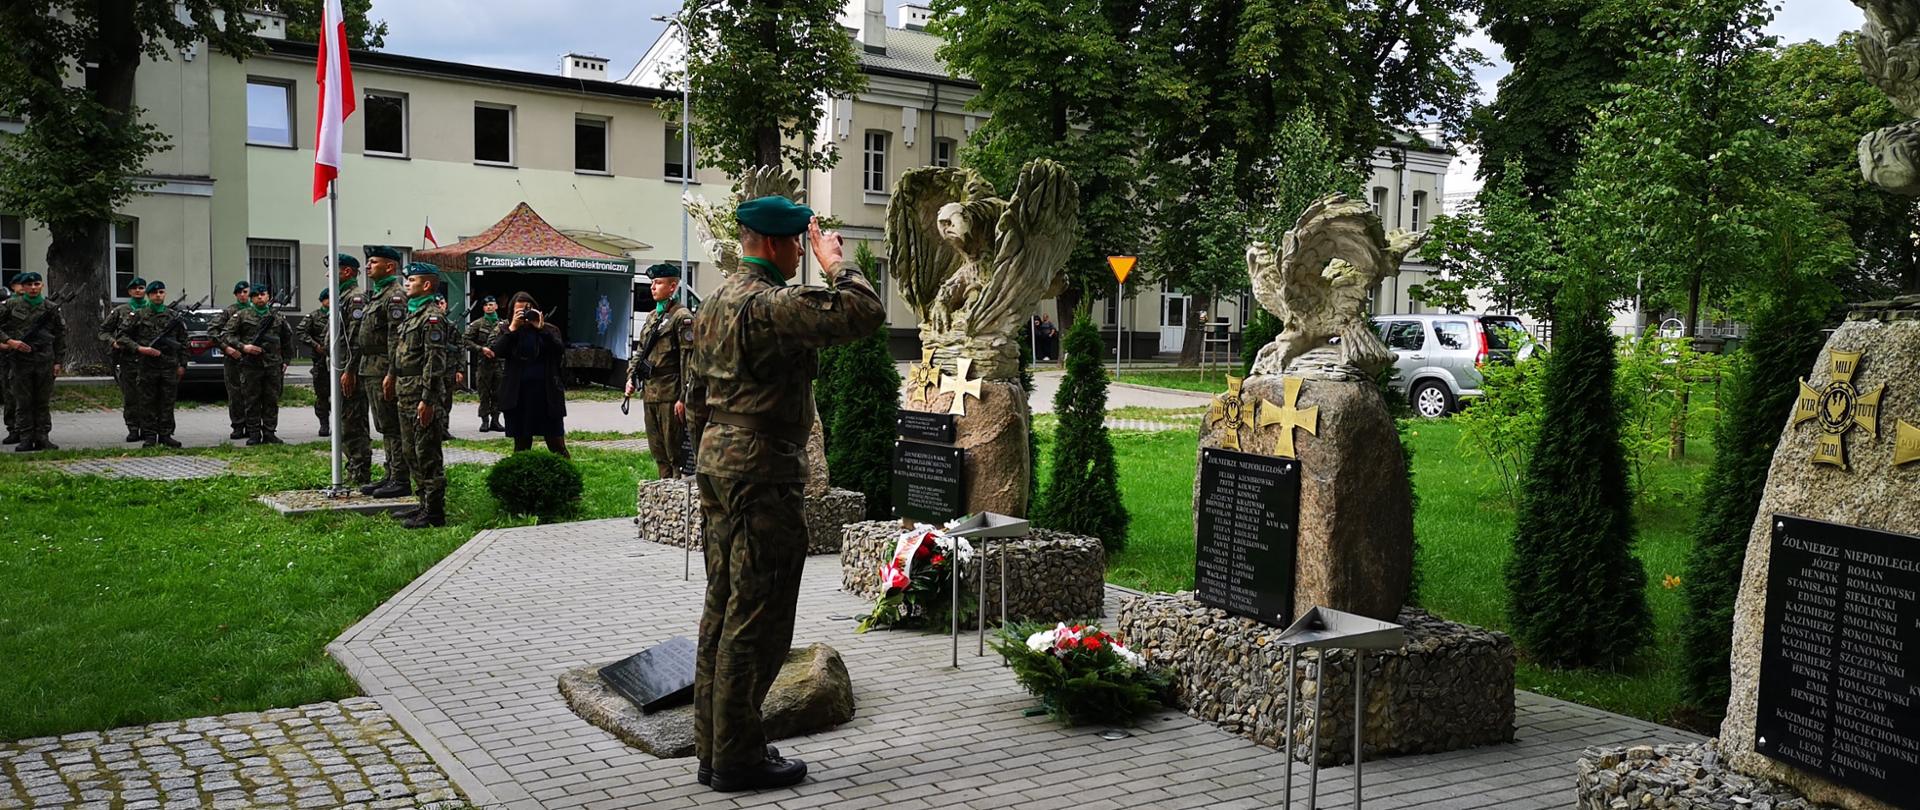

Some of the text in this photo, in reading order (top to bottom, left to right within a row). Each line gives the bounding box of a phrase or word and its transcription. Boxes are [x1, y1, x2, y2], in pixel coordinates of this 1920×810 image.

[475, 256, 629, 273] 2 Przasnyski Ośrodek Radioelektroniczny
[1834, 360, 1852, 374] MILI
[1801, 398, 1816, 412] VIR
[1821, 442, 1838, 457] TARI
[1782, 534, 1839, 557] ŻOŁNIERZE
[1801, 567, 1915, 600] HENRYK ROMANOWSKI
[1811, 556, 1883, 580] JÓZEF ROMAN
[1786, 576, 1895, 610] STANISŁAW SIEKLICKI
[1797, 590, 1897, 622] EDMUND SMOLIŃSKI
[1784, 612, 1903, 651] KAZIMIERZ SOKOLNICKI
[1785, 600, 1835, 621] KAZIMIERZ
[1842, 614, 1896, 636] SMOLIŃSKI
[1780, 623, 1898, 663] KONSTANTY STANOWSKI
[1781, 635, 1904, 678] KAZIMIERZ SZCZEPAŃSKI
[1781, 648, 1831, 670] KAZIMIERZ
[1838, 664, 1885, 686] SZREJTER
[1792, 663, 1909, 706] HENRYK TOMASZEWSKI
[1805, 680, 1828, 695] EMIL
[1790, 687, 1893, 728] HENRYK WIECZOREK
[1776, 707, 1917, 764] KAZIMIERZ WOJCIECHOWSKI
[1788, 723, 1824, 743] TEODOR
[1809, 706, 1919, 750] JAN WOJCIECHOWSKI
[1778, 743, 1822, 768] ŻOŁNIERZ
[1799, 739, 1885, 779] LEON ŻBIKOWSKI
